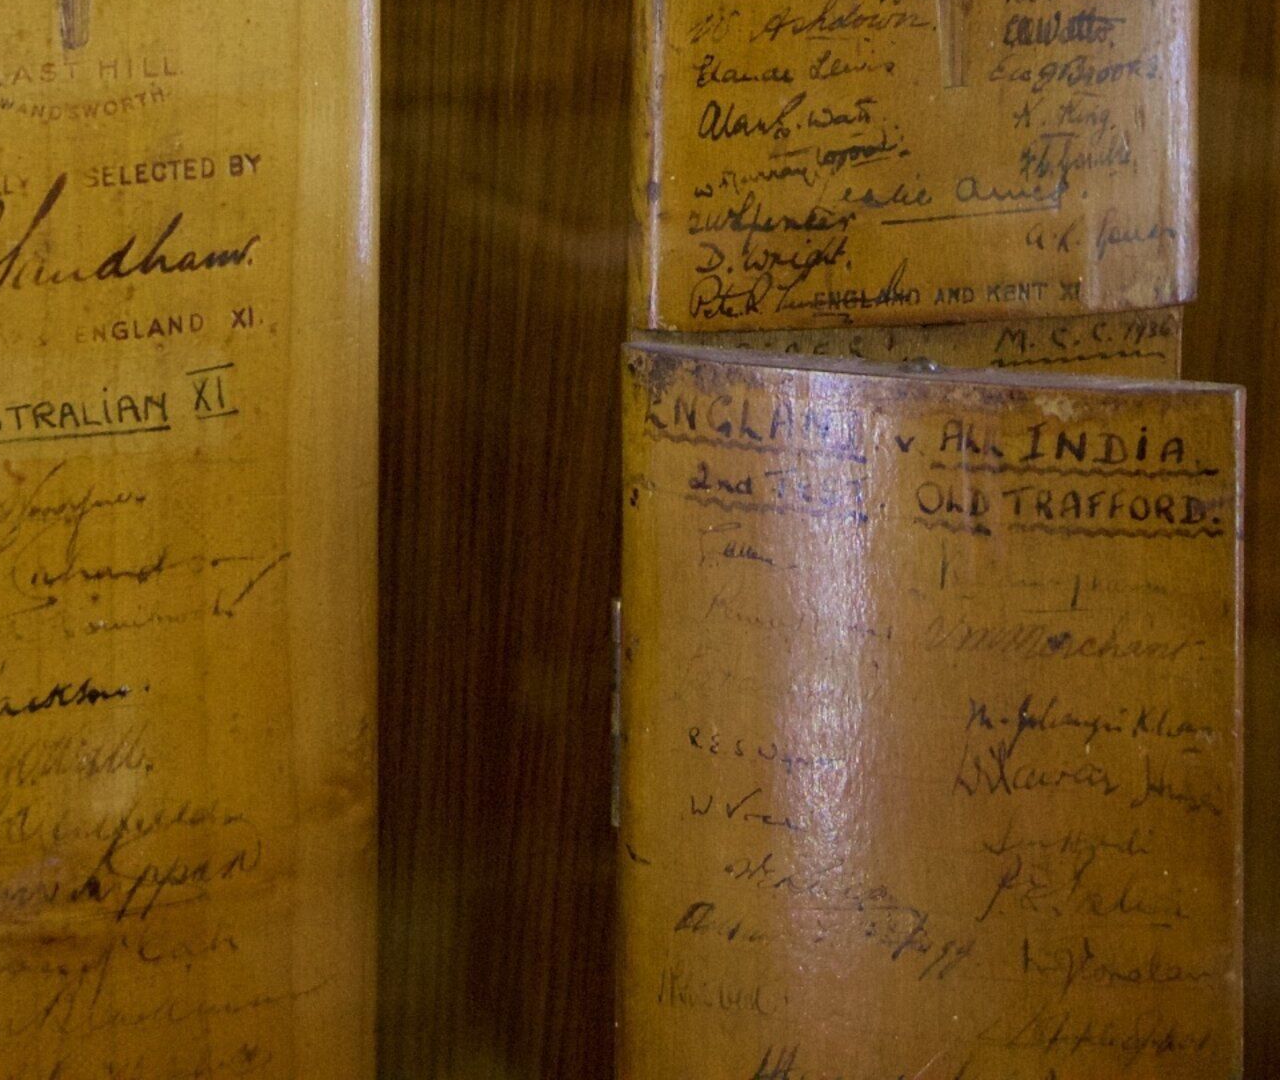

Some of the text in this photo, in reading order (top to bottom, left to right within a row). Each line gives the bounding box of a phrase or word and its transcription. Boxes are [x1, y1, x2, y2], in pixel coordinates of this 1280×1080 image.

[85, 157, 217, 189] SELECTED
[228, 153, 263, 178] BY
[813, 287, 922, 310] ENGLAND
[933, 286, 975, 306] AND
[986, 282, 1048, 303] KENT
[75, 313, 206, 344] ENGLAND
[188, 368, 234, 416] XI
[687, 461, 754, 496] 2nd
[915, 481, 990, 518] OLD
